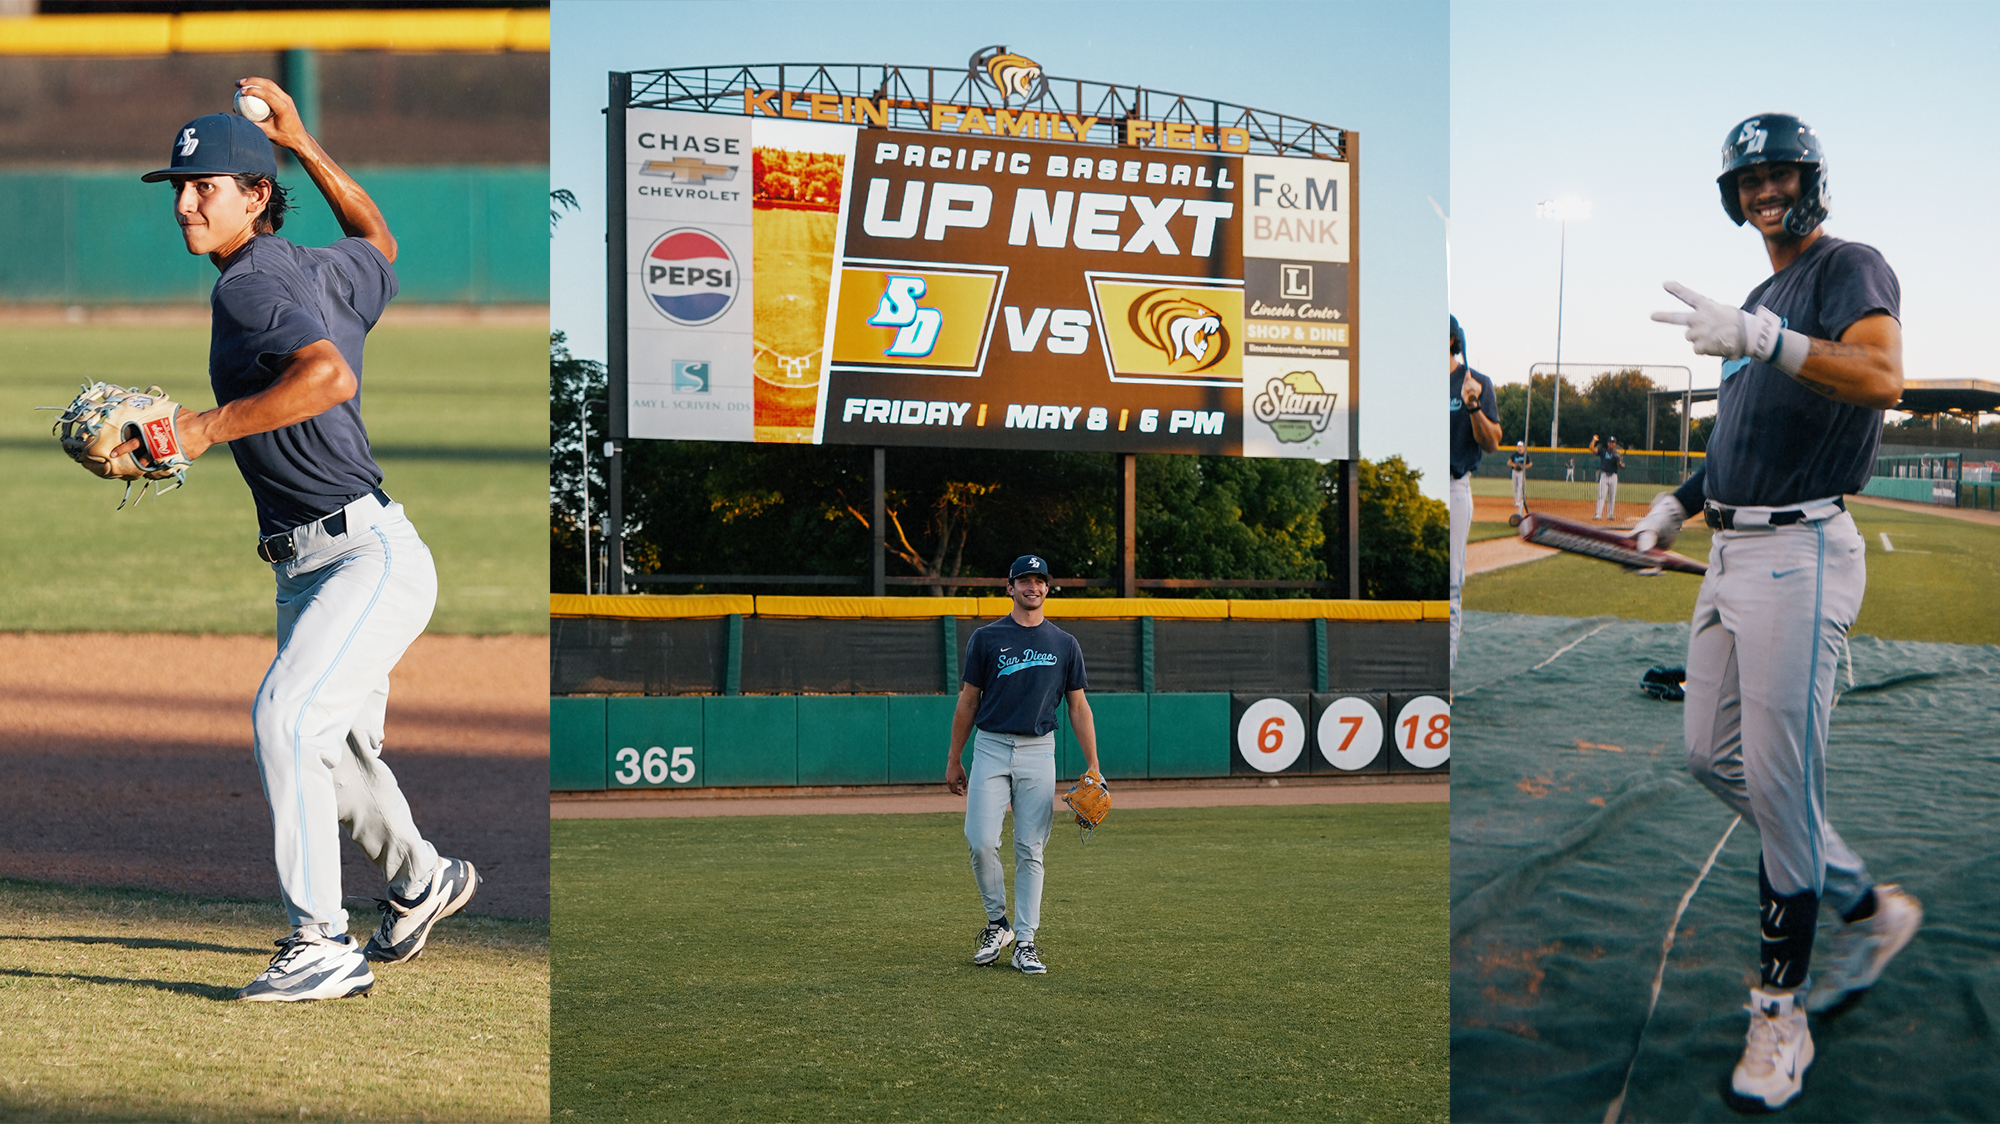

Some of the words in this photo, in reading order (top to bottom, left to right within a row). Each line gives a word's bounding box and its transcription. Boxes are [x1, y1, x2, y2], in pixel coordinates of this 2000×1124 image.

[744, 88, 889, 126] KLEIN
[932, 105, 1098, 142] FAMILY
[1127, 120, 1251, 153] FIELD
[1736, 119, 1768, 155] SD
[176, 128, 199, 156] SD
[638, 132, 740, 155] CHASE
[875, 142, 1031, 175] PACIFIC
[1046, 155, 1234, 189] BASEBALL
[638, 185, 740, 202] CHEVROLET
[1254, 173, 1338, 212] F&M
[863, 177, 993, 241] UP
[1008, 187, 1234, 257] NEXT
[1254, 215, 1338, 245] BANK
[649, 264, 732, 288] PEPSI
[1286, 268, 1307, 295] L
[866, 275, 943, 358] SD
[1250, 299, 1296, 317] Lincoln
[1297, 303, 1342, 319] Center
[1003, 306, 1093, 355] VS
[1247, 324, 1291, 340] SHOP
[1293, 326, 1305, 340] &
[1310, 327, 1346, 342] DINE
[633, 399, 658, 409] AMY
[727, 402, 751, 412] DDS
[842, 398, 971, 426] FRIDAY
[1005, 404, 1082, 430] MAY
[1086, 407, 1108, 431] 8
[1139, 409, 1159, 433] 6
[1169, 410, 1225, 435] PM
[1254, 378, 1337, 432] Starry
[997, 654, 1020, 669] San
[1022, 648, 1055, 663] Diego
[1257, 716, 1285, 754] 6
[1337, 715, 1364, 752] 7
[1402, 713, 1450, 750] 18
[615, 746, 696, 785] 365
